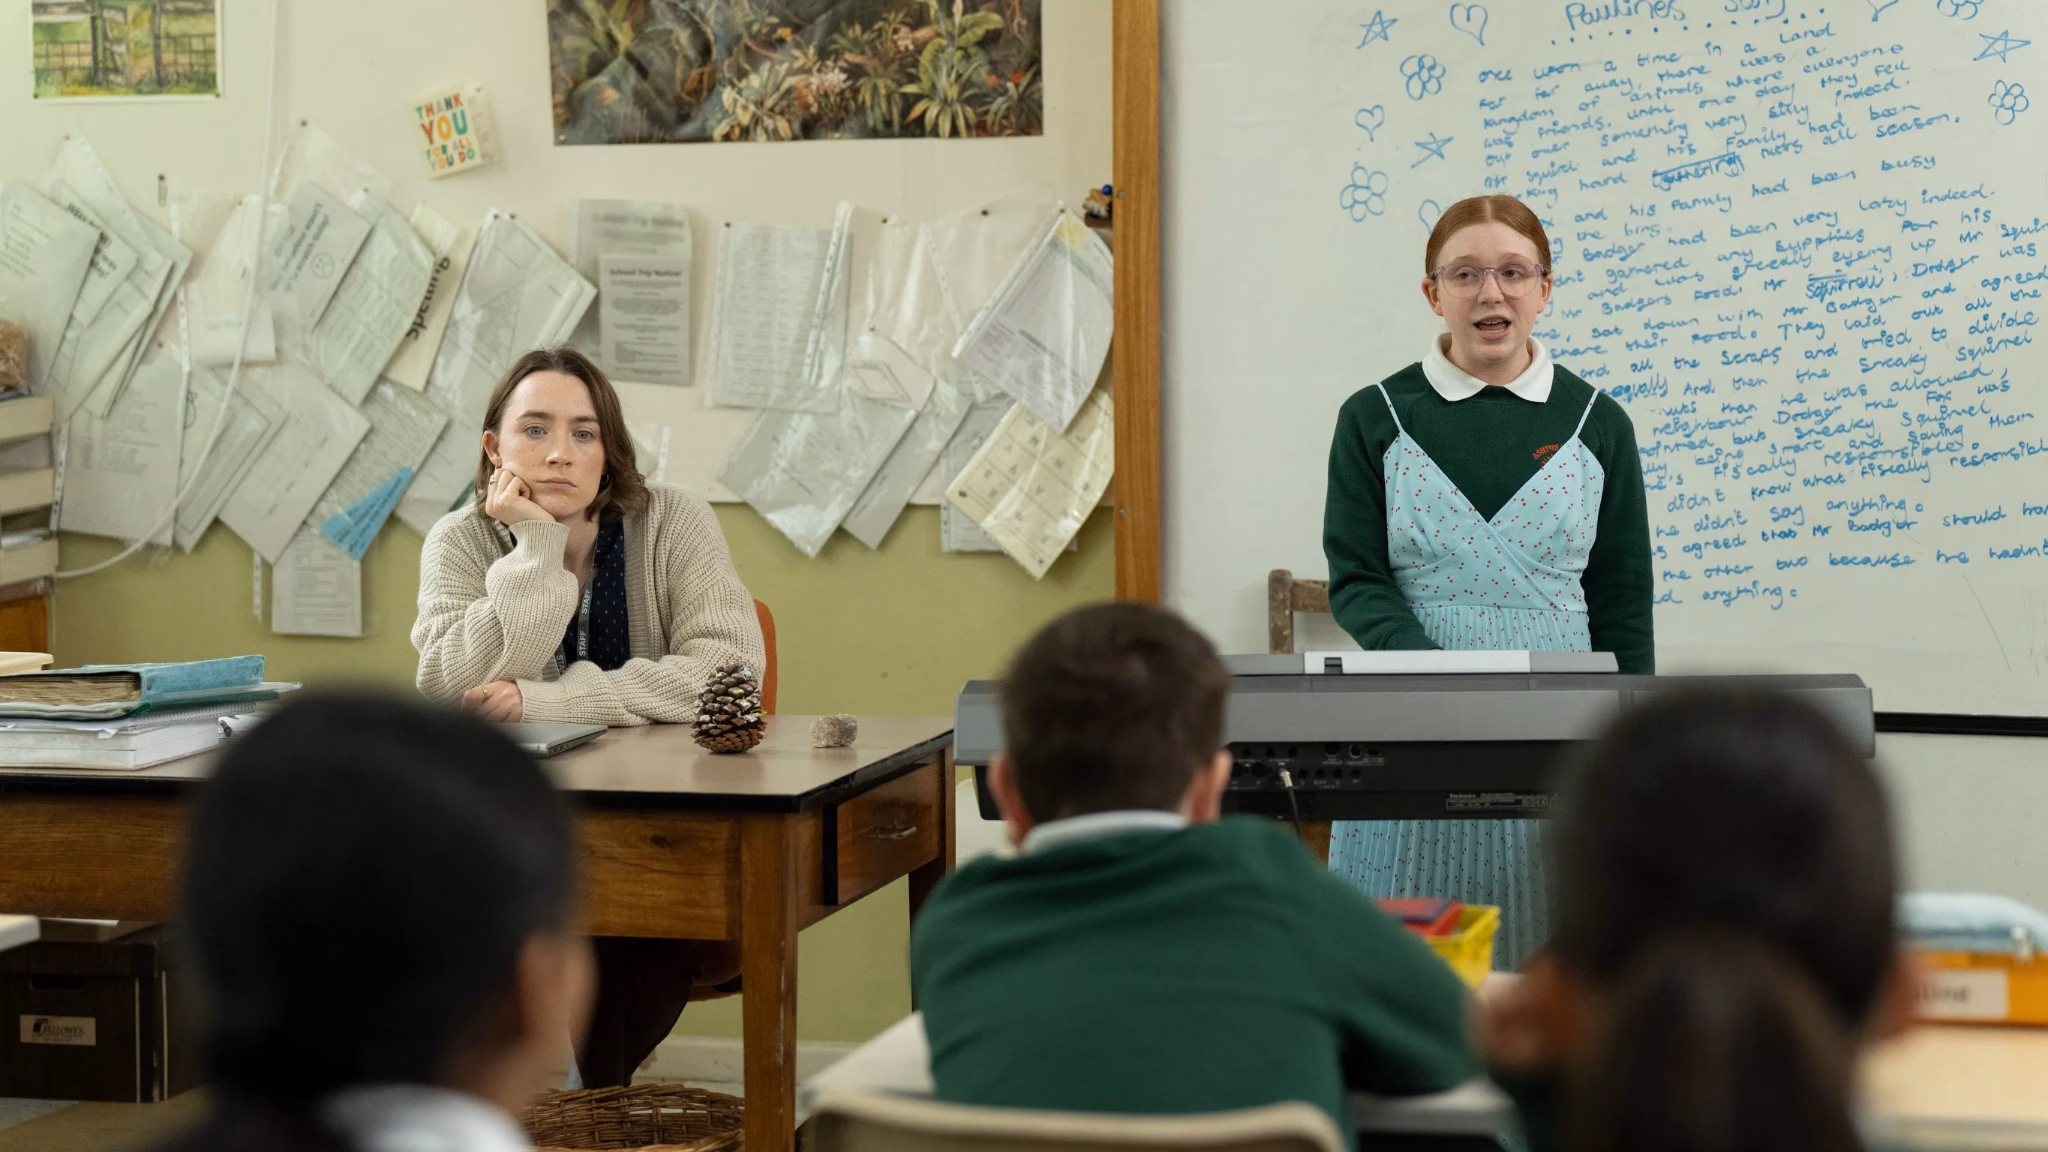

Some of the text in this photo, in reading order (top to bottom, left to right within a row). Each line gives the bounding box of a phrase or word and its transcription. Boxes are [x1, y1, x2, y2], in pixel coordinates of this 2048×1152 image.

[1534, 63, 1581, 79] upon
[1603, 60, 1617, 72] a
[1637, 53, 1682, 66] time
[1705, 41, 1722, 56] in
[1744, 43, 1757, 53] a
[1726, 70, 1785, 88] where
[1803, 44, 1904, 73] everyone
[1740, 52, 1786, 68] was
[1806, 45, 1827, 57] a
[415, 92, 463, 119] THANK
[1755, 83, 1795, 107] day
[421, 109, 468, 145] YOU
[1601, 149, 1638, 167] and
[1667, 136, 1697, 156] his
[1808, 112, 1847, 135] had
[1869, 104, 1921, 121] been
[1705, 113, 1747, 136] very
[1768, 101, 1809, 125] silly
[1822, 127, 1857, 145] all
[430, 148, 475, 171] YOU DO
[1574, 154, 1937, 223] and his had been busy
[1668, 230, 1708, 246] had
[1729, 221, 1777, 237] been
[1793, 209, 1839, 228] very
[1717, 249, 1755, 264] any
[1960, 207, 1992, 224] his
[1588, 282, 1628, 300] and
[1654, 272, 1704, 287] was
[1911, 238, 1937, 254] up
[1959, 231, 1983, 244] Mr
[1764, 278, 1786, 291] Mr
[1999, 243, 2037, 258] was
[1591, 327, 1624, 340] sat
[1644, 317, 1699, 331] down
[1717, 308, 1763, 322] with
[1922, 284, 1956, 298] and
[1777, 320, 1826, 340] They
[1844, 315, 1887, 330] laid
[1910, 306, 1944, 320] out
[1965, 299, 1993, 312] all
[2010, 288, 2043, 302] the
[1630, 357, 1654, 372] all
[1674, 356, 1700, 369] the
[1804, 343, 1839, 359] and
[1861, 329, 1912, 349] tried
[1931, 327, 1948, 343] to
[1968, 311, 2040, 338] divide
[1732, 377, 1769, 391] then
[1796, 368, 1831, 385] the
[1721, 402, 1758, 415] than
[1780, 392, 1808, 406] he
[1823, 386, 1868, 400] was
[1772, 405, 1843, 425] Dodger
[1865, 399, 1900, 411] the
[1977, 377, 2011, 396] was
[1732, 431, 1767, 445] but
[1849, 433, 1884, 449] and
[1989, 411, 2035, 429] them
[1803, 472, 1846, 489] what
[1770, 504, 1805, 526] say
[1682, 534, 1747, 559] agreed
[1761, 528, 1798, 542] that
[1812, 524, 1833, 537] Mr
[1663, 570, 1692, 581] the
[1704, 564, 1753, 579] other
[1776, 555, 1809, 571] two
[1829, 552, 1916, 568] because
[1936, 548, 1970, 565] he
[582, 589, 592, 614] STAFF
[579, 630, 587, 657] STAFF
